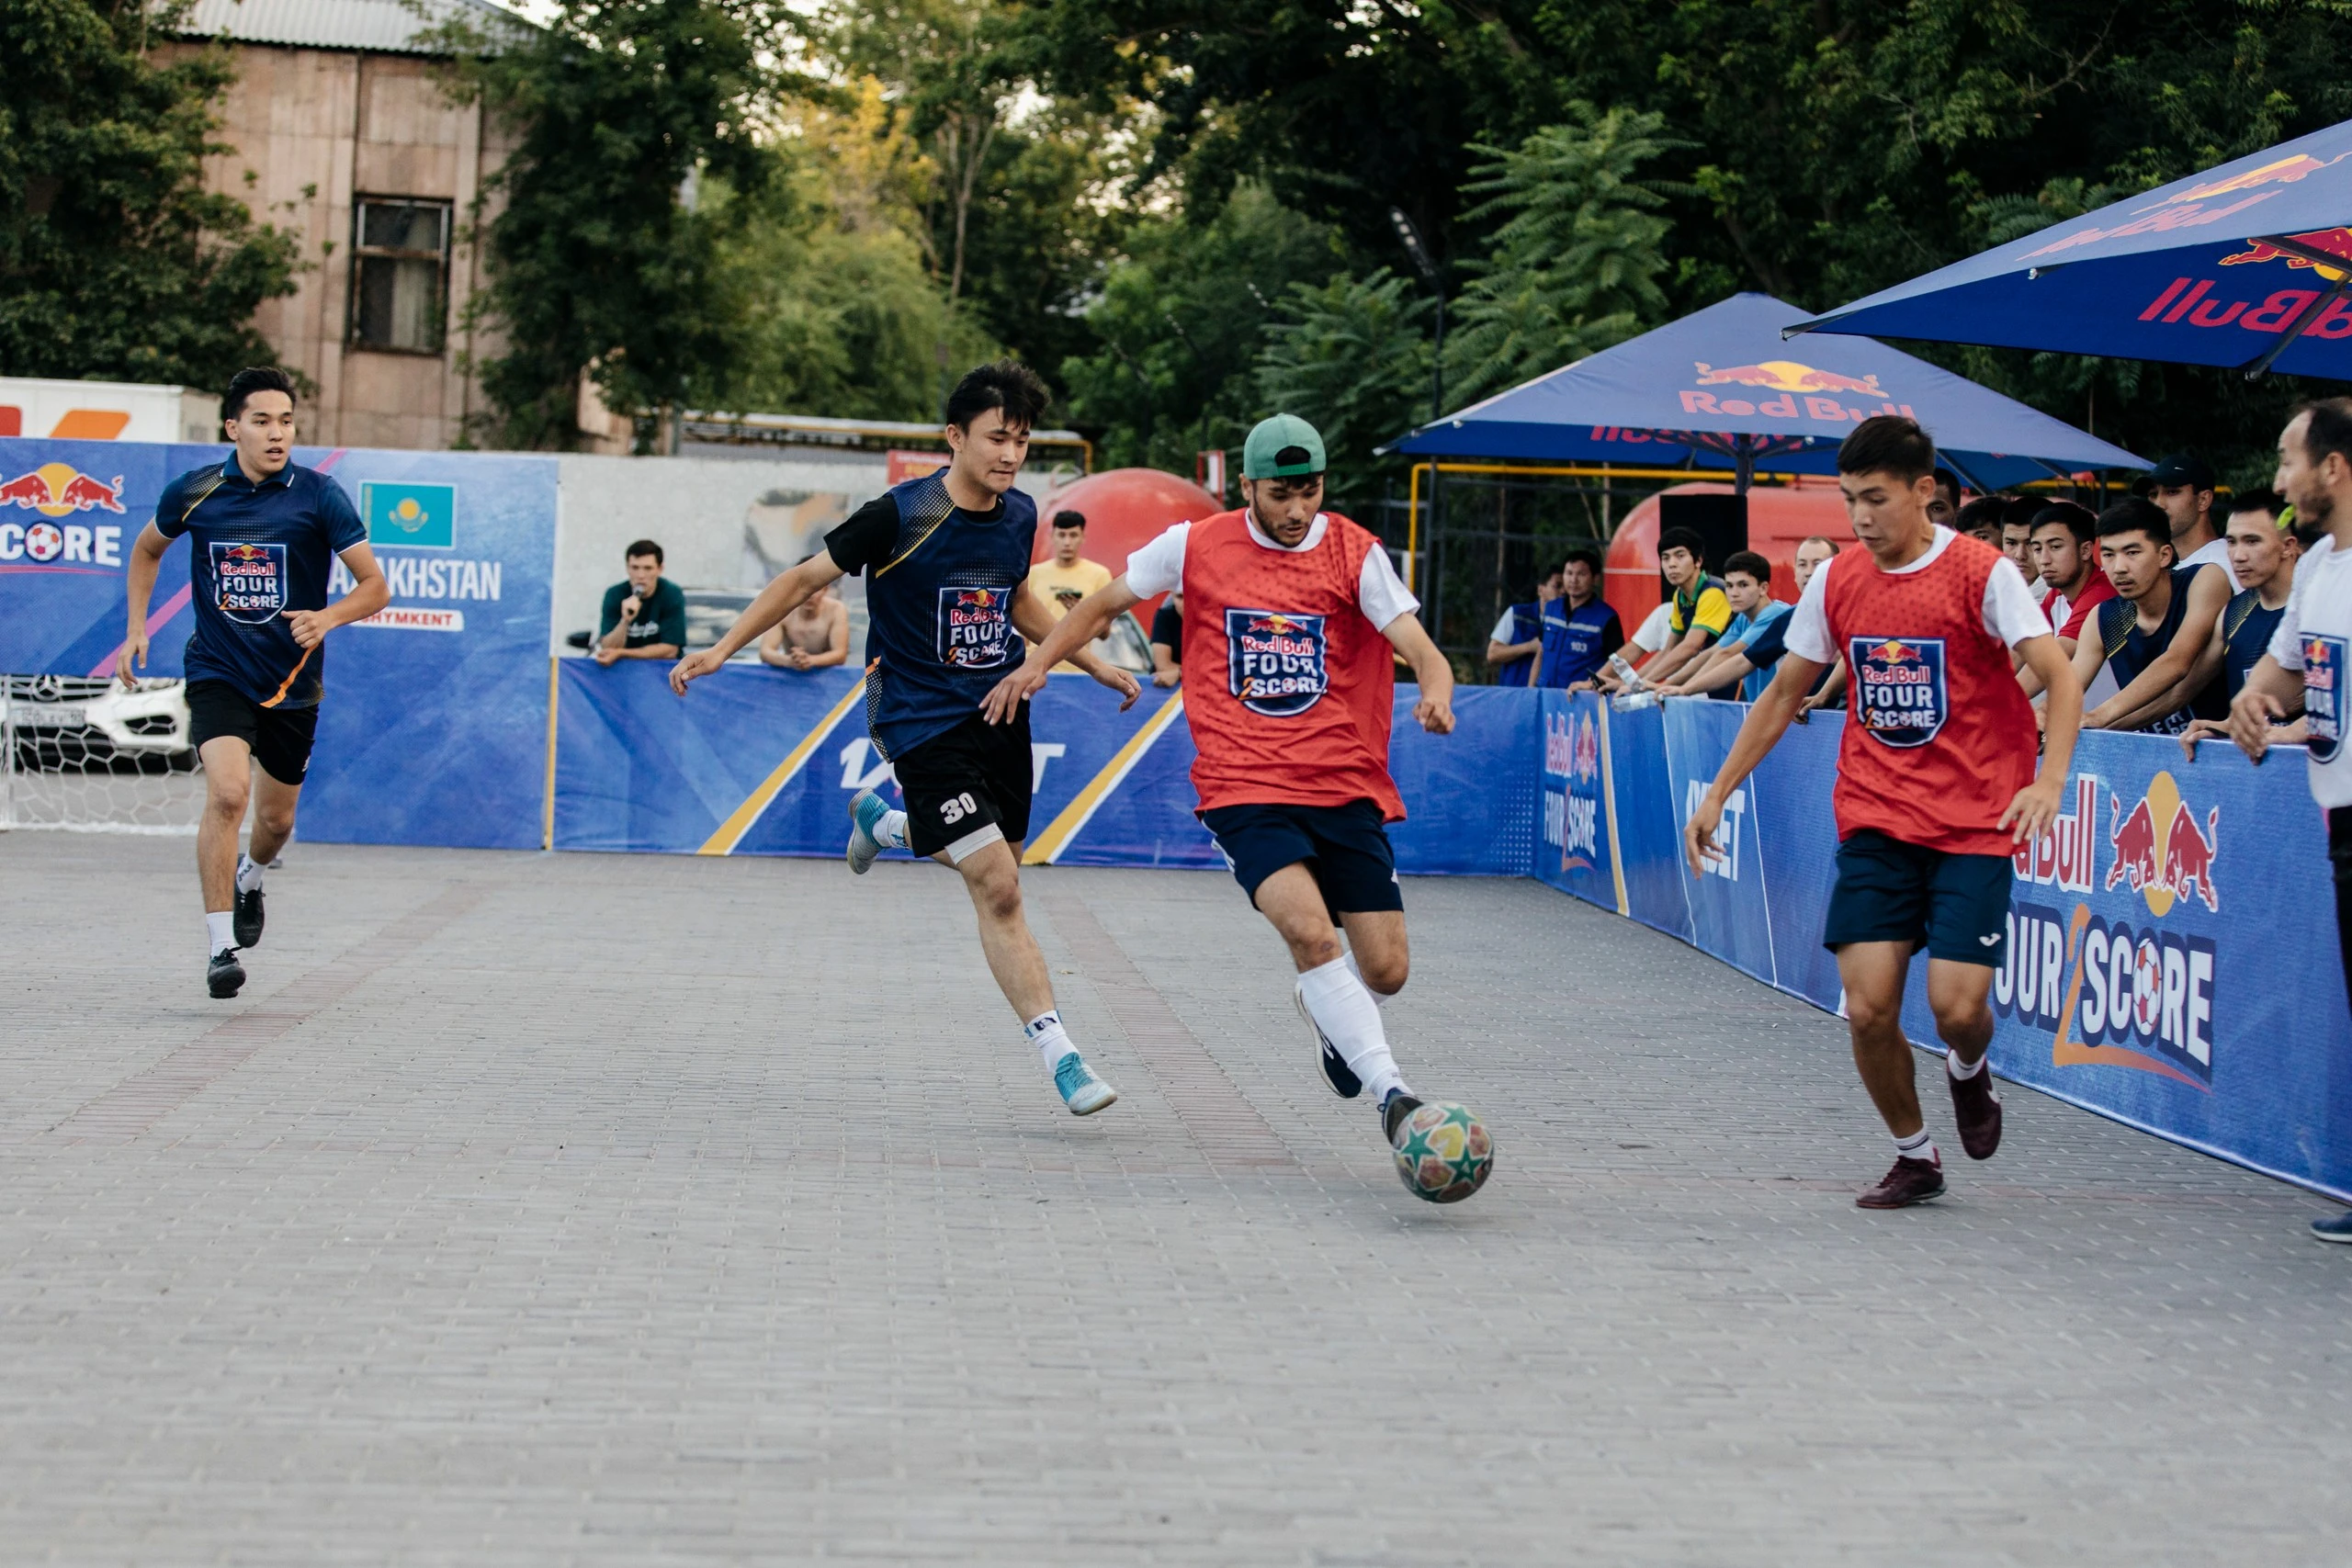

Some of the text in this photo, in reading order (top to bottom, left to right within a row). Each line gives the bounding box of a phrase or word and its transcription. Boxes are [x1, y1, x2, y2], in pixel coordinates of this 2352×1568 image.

[1679, 390, 1800, 419] Red
[0, 523, 122, 568] CORE
[220, 561, 277, 577] Red Bull
[328, 557, 502, 602] AKHSTAN
[222, 576, 278, 593] FOUR
[950, 607, 981, 626] Red
[950, 621, 1007, 646] FOUR
[1240, 635, 1316, 657] Red Bull
[1243, 653, 1318, 678] FOUR
[1861, 664, 1930, 684] Red Bull
[1863, 685, 1934, 708] FOUR
[939, 792, 978, 825] 30
[1995, 911, 2064, 1019] OUR
